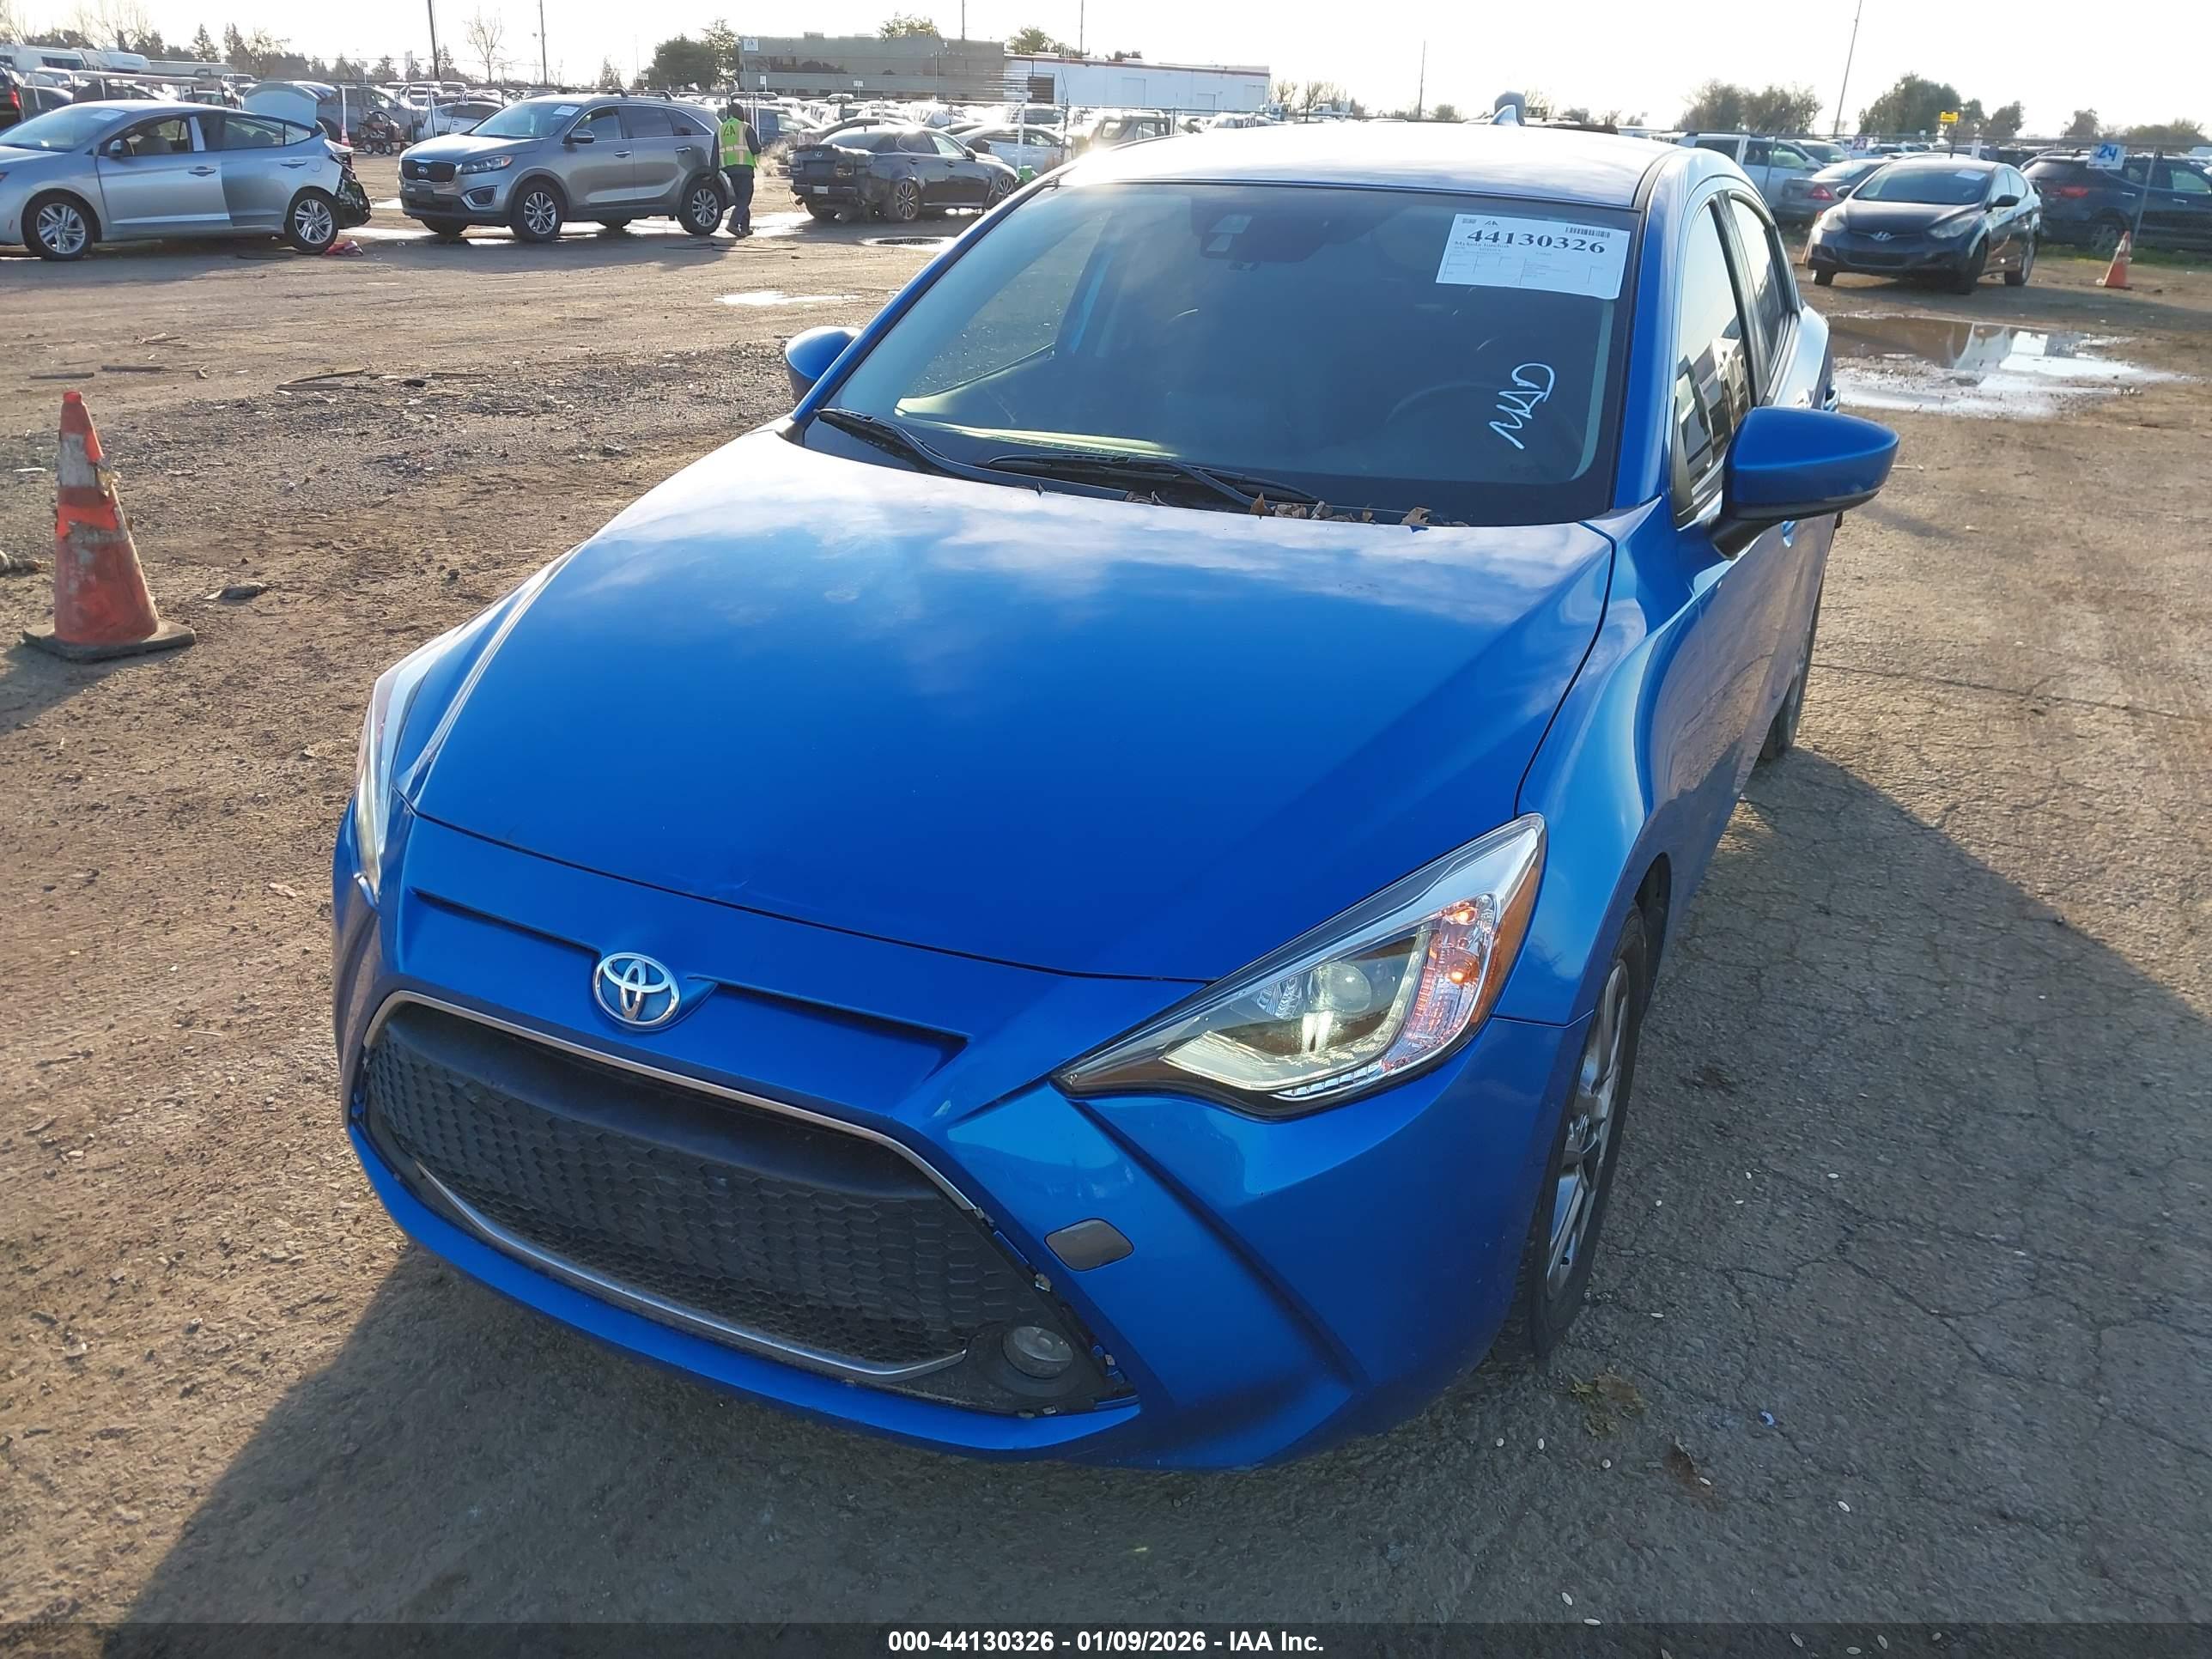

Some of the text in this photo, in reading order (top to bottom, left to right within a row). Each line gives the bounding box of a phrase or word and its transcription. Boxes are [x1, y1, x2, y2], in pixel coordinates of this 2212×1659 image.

[1244, 117, 1256, 127] 20
[1853, 137, 1868, 150] 23
[2097, 144, 2118, 161] 24
[1467, 229, 1606, 254] 44130326
